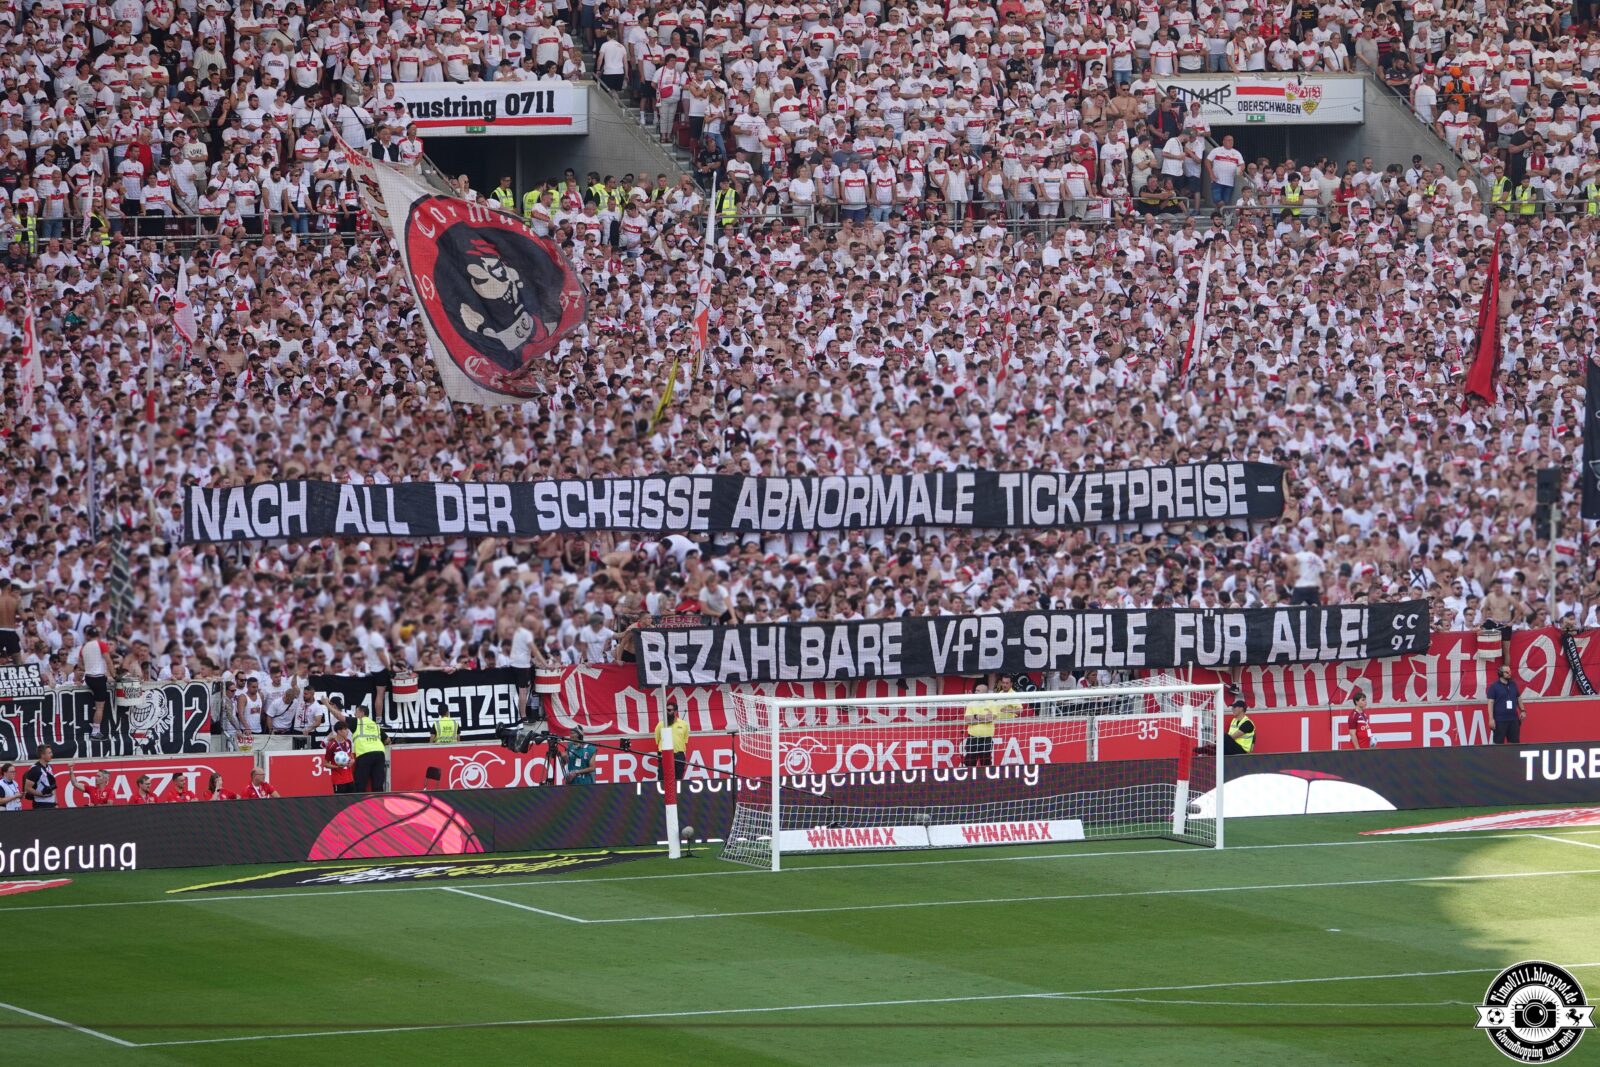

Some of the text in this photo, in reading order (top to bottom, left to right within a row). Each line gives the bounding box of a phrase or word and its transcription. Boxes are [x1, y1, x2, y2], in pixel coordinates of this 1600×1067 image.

[400, 90, 555, 122] rustring 0711
[1237, 100, 1301, 114] OBERSCHWABEN
[191, 481, 307, 540] NACH
[335, 483, 410, 535] ALL
[435, 482, 515, 534] DER
[534, 475, 713, 531] SCHEISSE
[731, 473, 976, 530] ABNORMALE
[999, 464, 1248, 525] TICKETPREISE
[1392, 614, 1419, 630] CC
[640, 608, 1369, 684] BEZAHLBARE VfB-SPIELE FÜR ALLE!
[1391, 634, 1415, 650] 97
[0, 677, 41, 689] EUTET
[1137, 720, 1159, 740] 35
[505, 748, 738, 788] JOERSAR
[806, 826, 897, 848] WINAMAX
[961, 821, 1053, 842] WINAMAX
